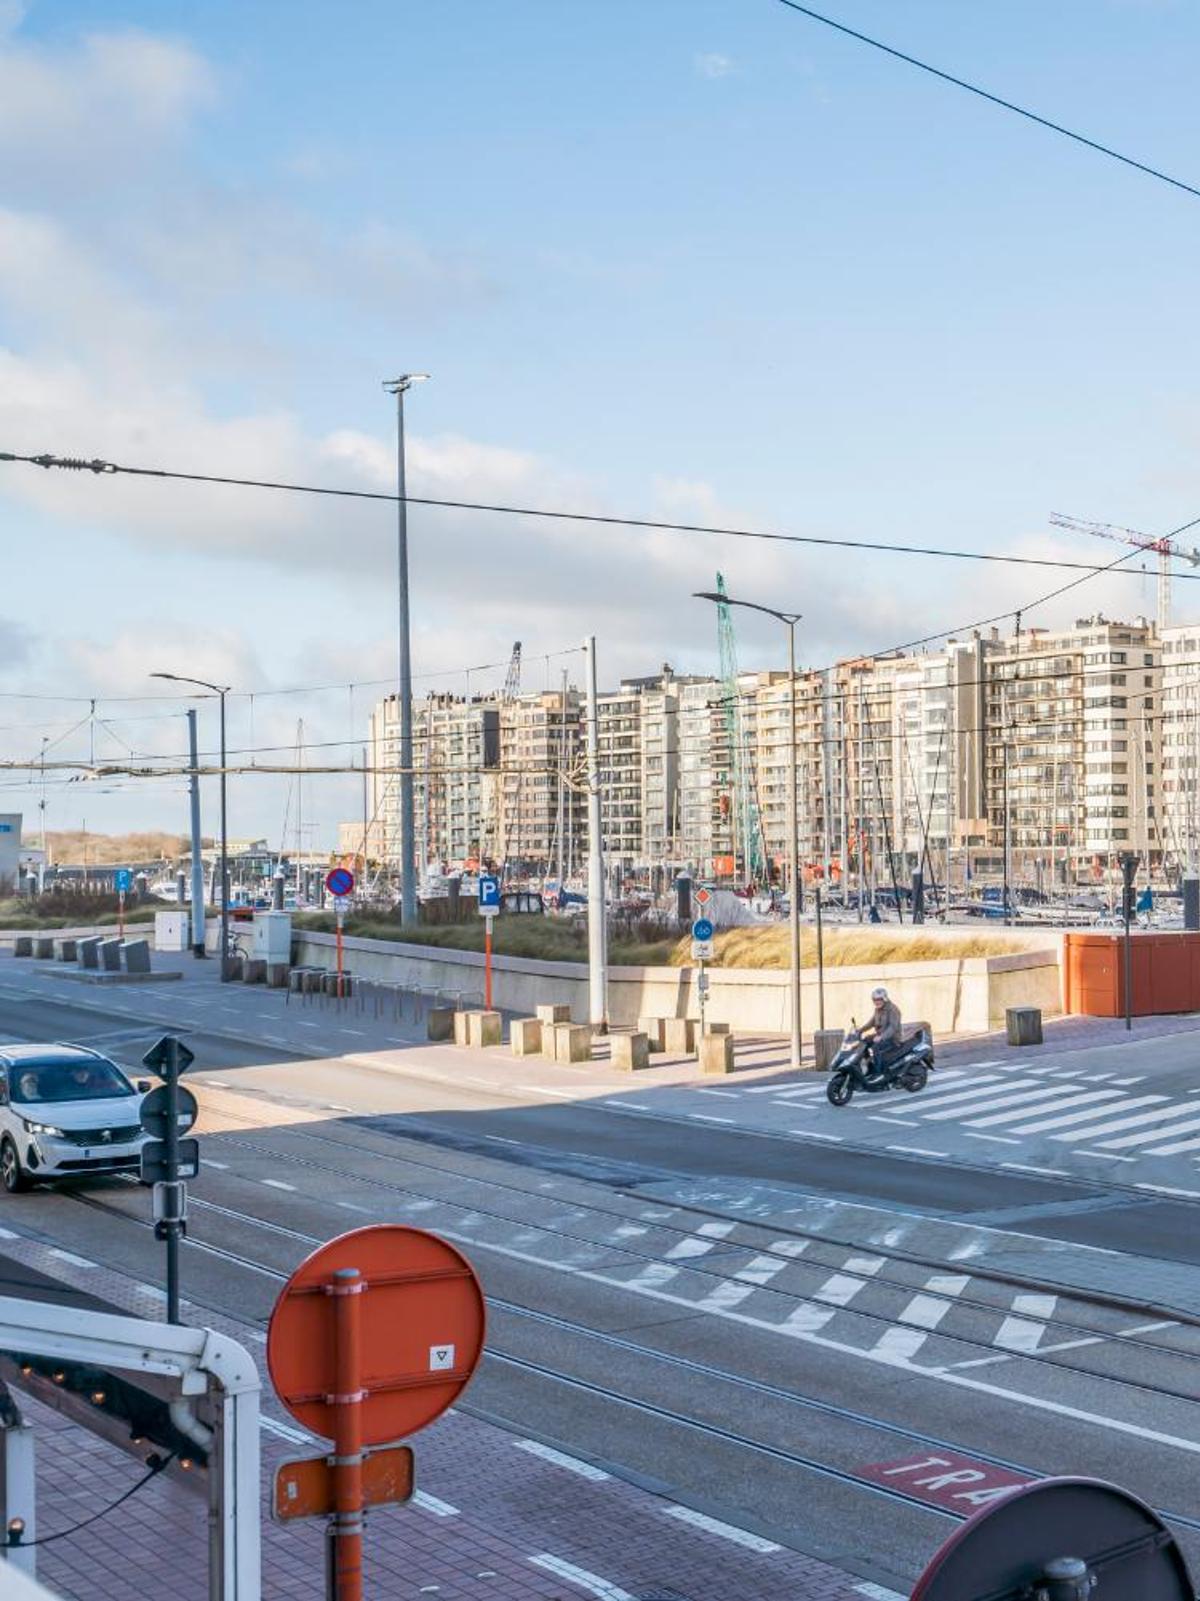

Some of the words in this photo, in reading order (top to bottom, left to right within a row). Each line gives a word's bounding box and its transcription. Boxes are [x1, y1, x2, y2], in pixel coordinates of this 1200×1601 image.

[119, 871, 127, 882] P
[482, 881, 496, 902] P
[882, 1456, 1024, 1505] TRA
